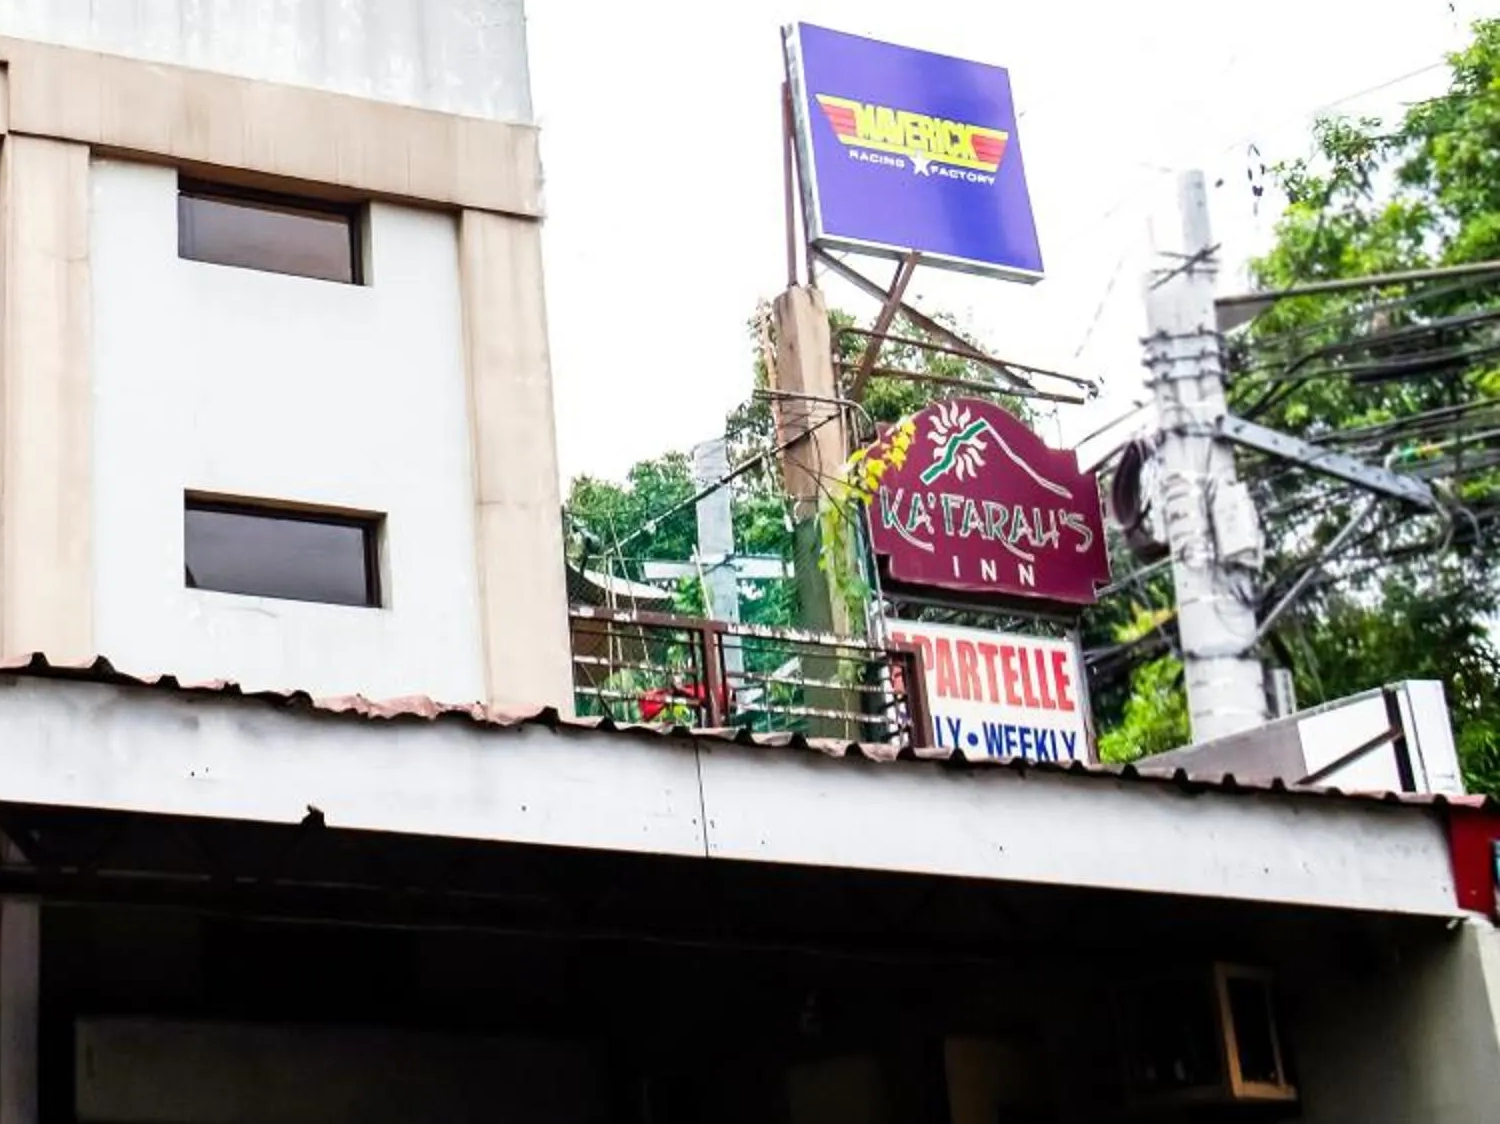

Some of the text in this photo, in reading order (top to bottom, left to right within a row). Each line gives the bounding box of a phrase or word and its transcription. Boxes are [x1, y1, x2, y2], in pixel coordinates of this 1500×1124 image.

[854, 102, 978, 161] MAVERICK
[849, 149, 996, 186] RACING FACTORY
